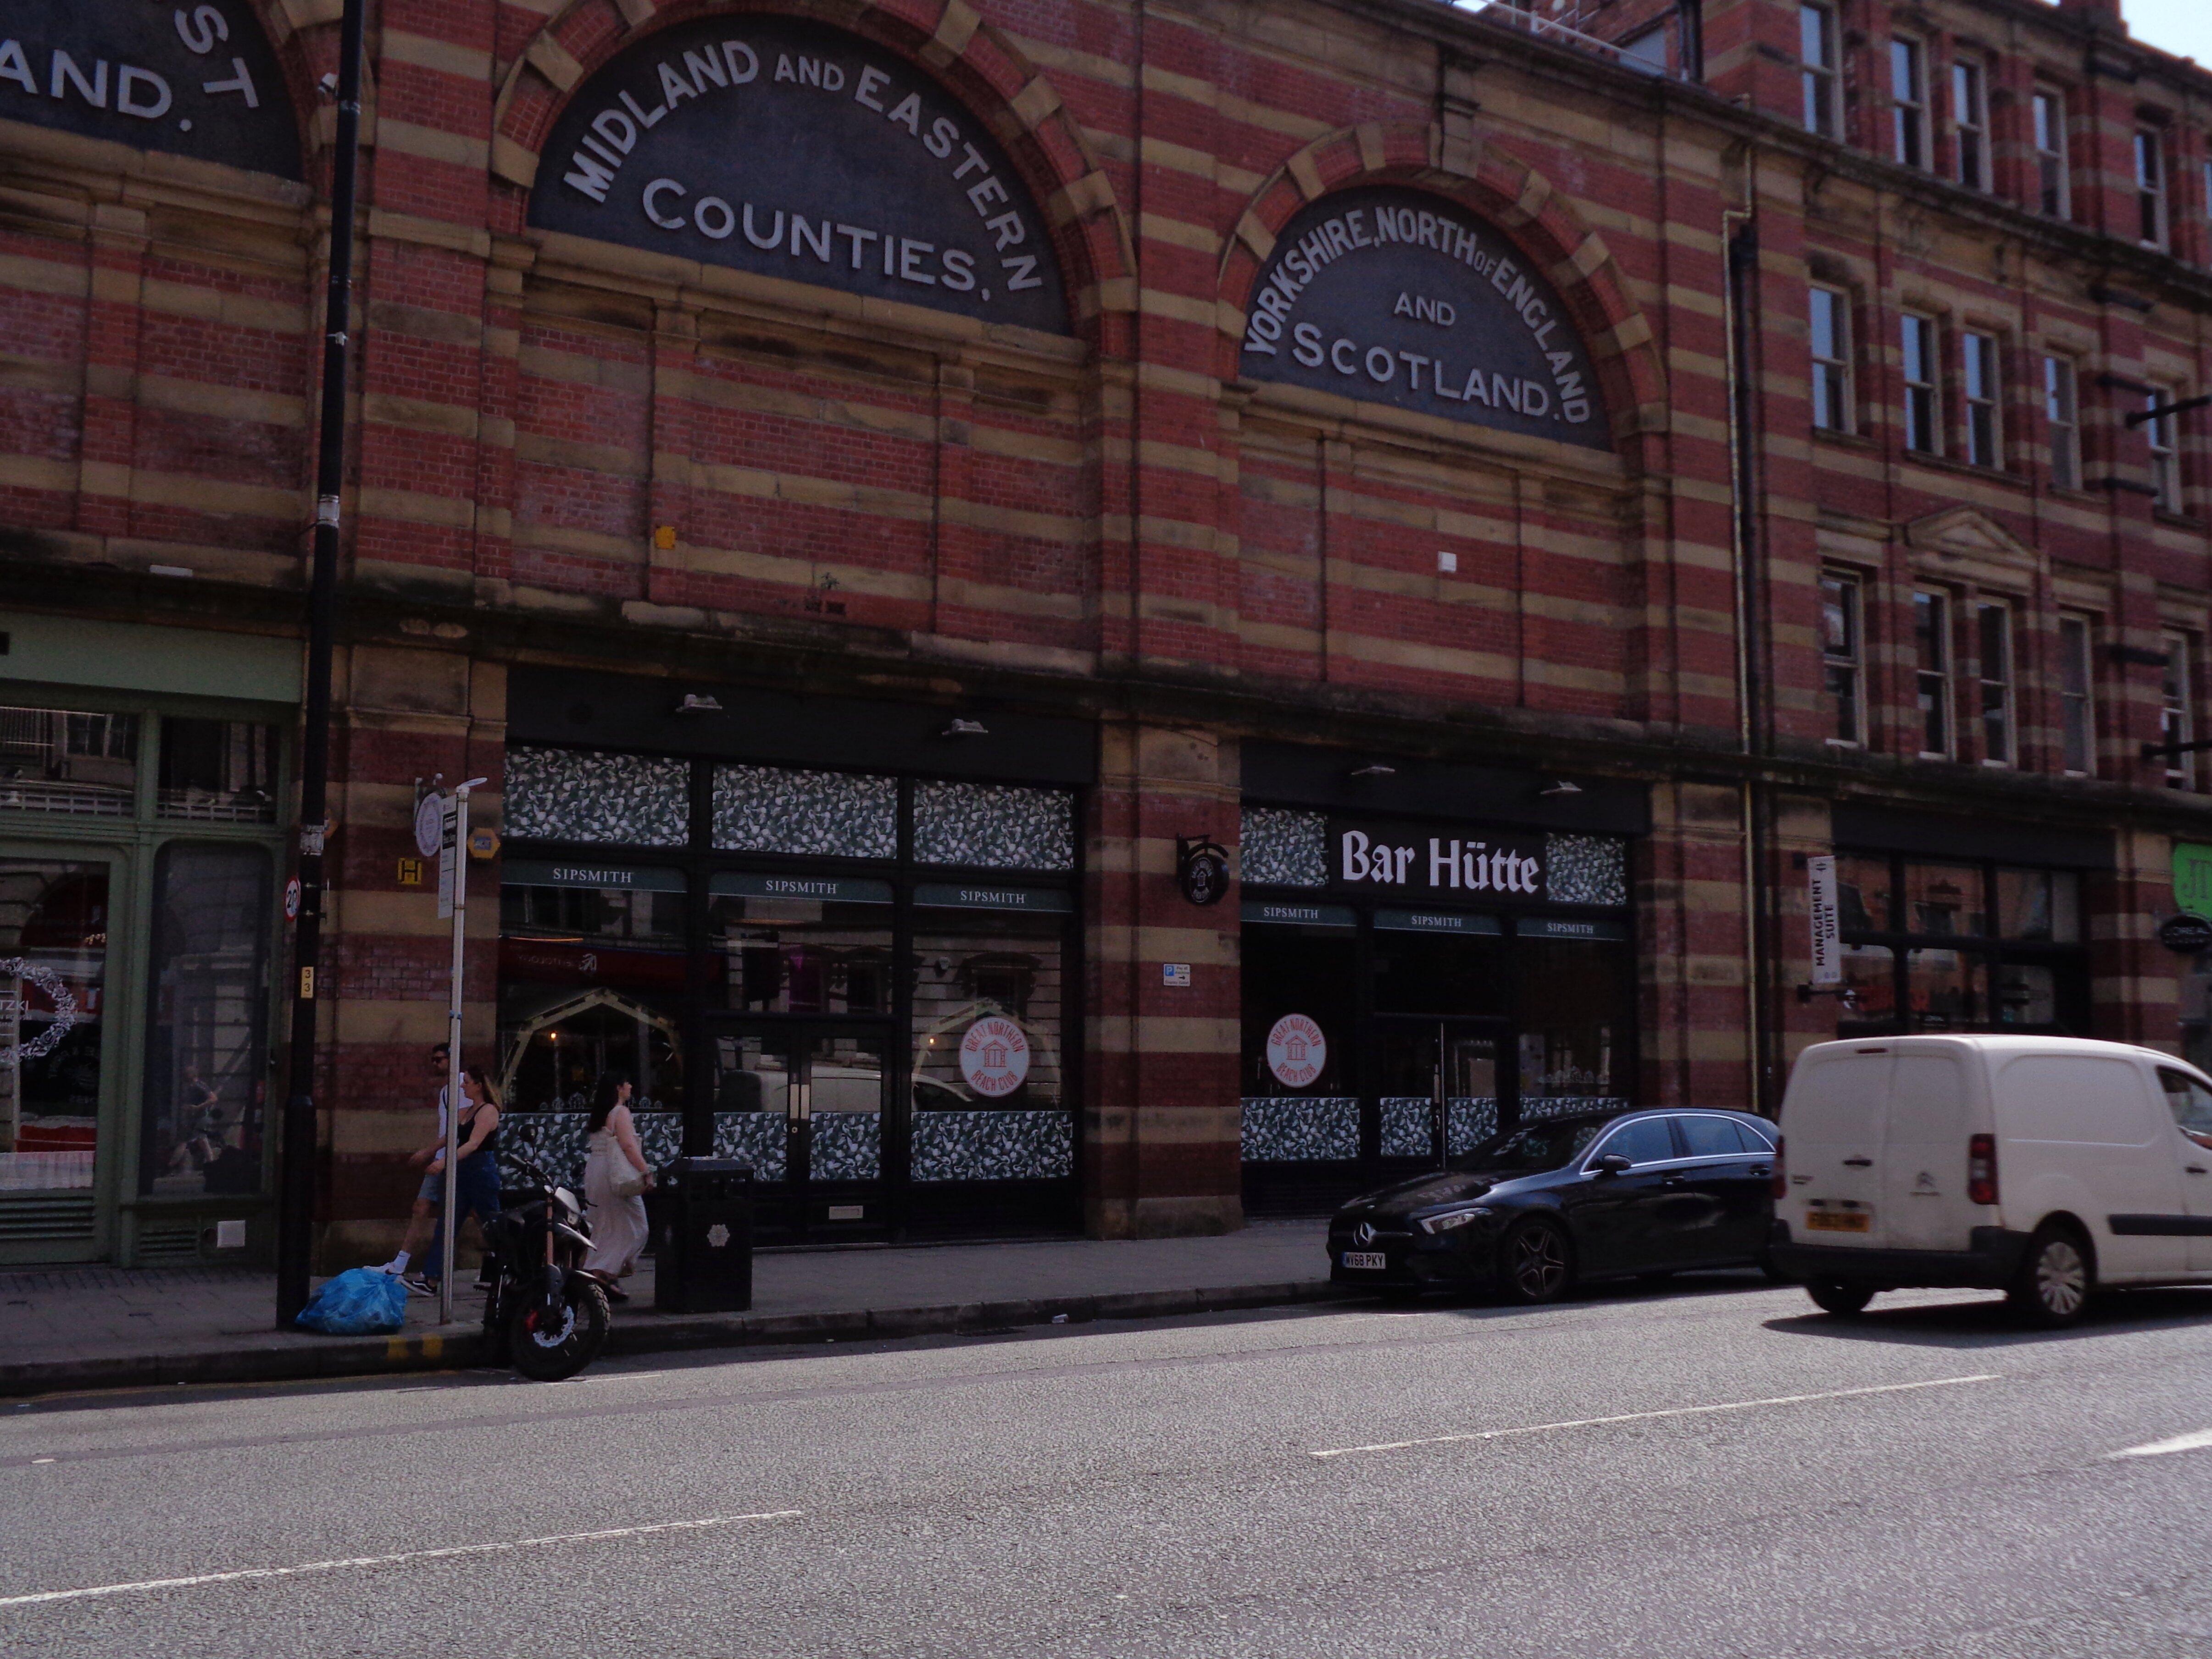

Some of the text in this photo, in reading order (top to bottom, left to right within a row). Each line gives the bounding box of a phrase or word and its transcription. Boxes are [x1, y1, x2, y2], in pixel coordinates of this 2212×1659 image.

[563, 40, 1043, 292] MIDLAND AND EASTERN
[642, 178, 990, 302] COUNTIES.
[1376, 206, 1478, 267] NORTH
[1473, 249, 1497, 277] OF
[1490, 256, 1591, 424] ENGLAND
[1394, 291, 1456, 327] AND
[1292, 322, 1561, 421] SCOTLAND.
[401, 860, 418, 883] H
[1341, 830, 1540, 894] Bar Hütte
[552, 867, 633, 884] SIPSMITH
[765, 879, 838, 895] SIPSMITH
[287, 889, 297, 913] 20
[959, 889, 1027, 904] SIPSMITH
[1263, 906, 1319, 920] SIPSMITH
[1411, 914, 1462, 929] SIPSMITH
[1812, 880, 1825, 966] MANAGEMENT
[1824, 904, 1835, 939] SUITE
[1546, 922, 1594, 935] SIPSMITH
[965, 1021, 1025, 1053] GREAT NORTHERN
[1271, 1018, 1322, 1047] GREAT NORTHERN
[971, 1069, 1018, 1091] BEACH CLUB
[1276, 1062, 1316, 1082] BEACH CLUB
[1366, 1254, 1383, 1266] PKY
